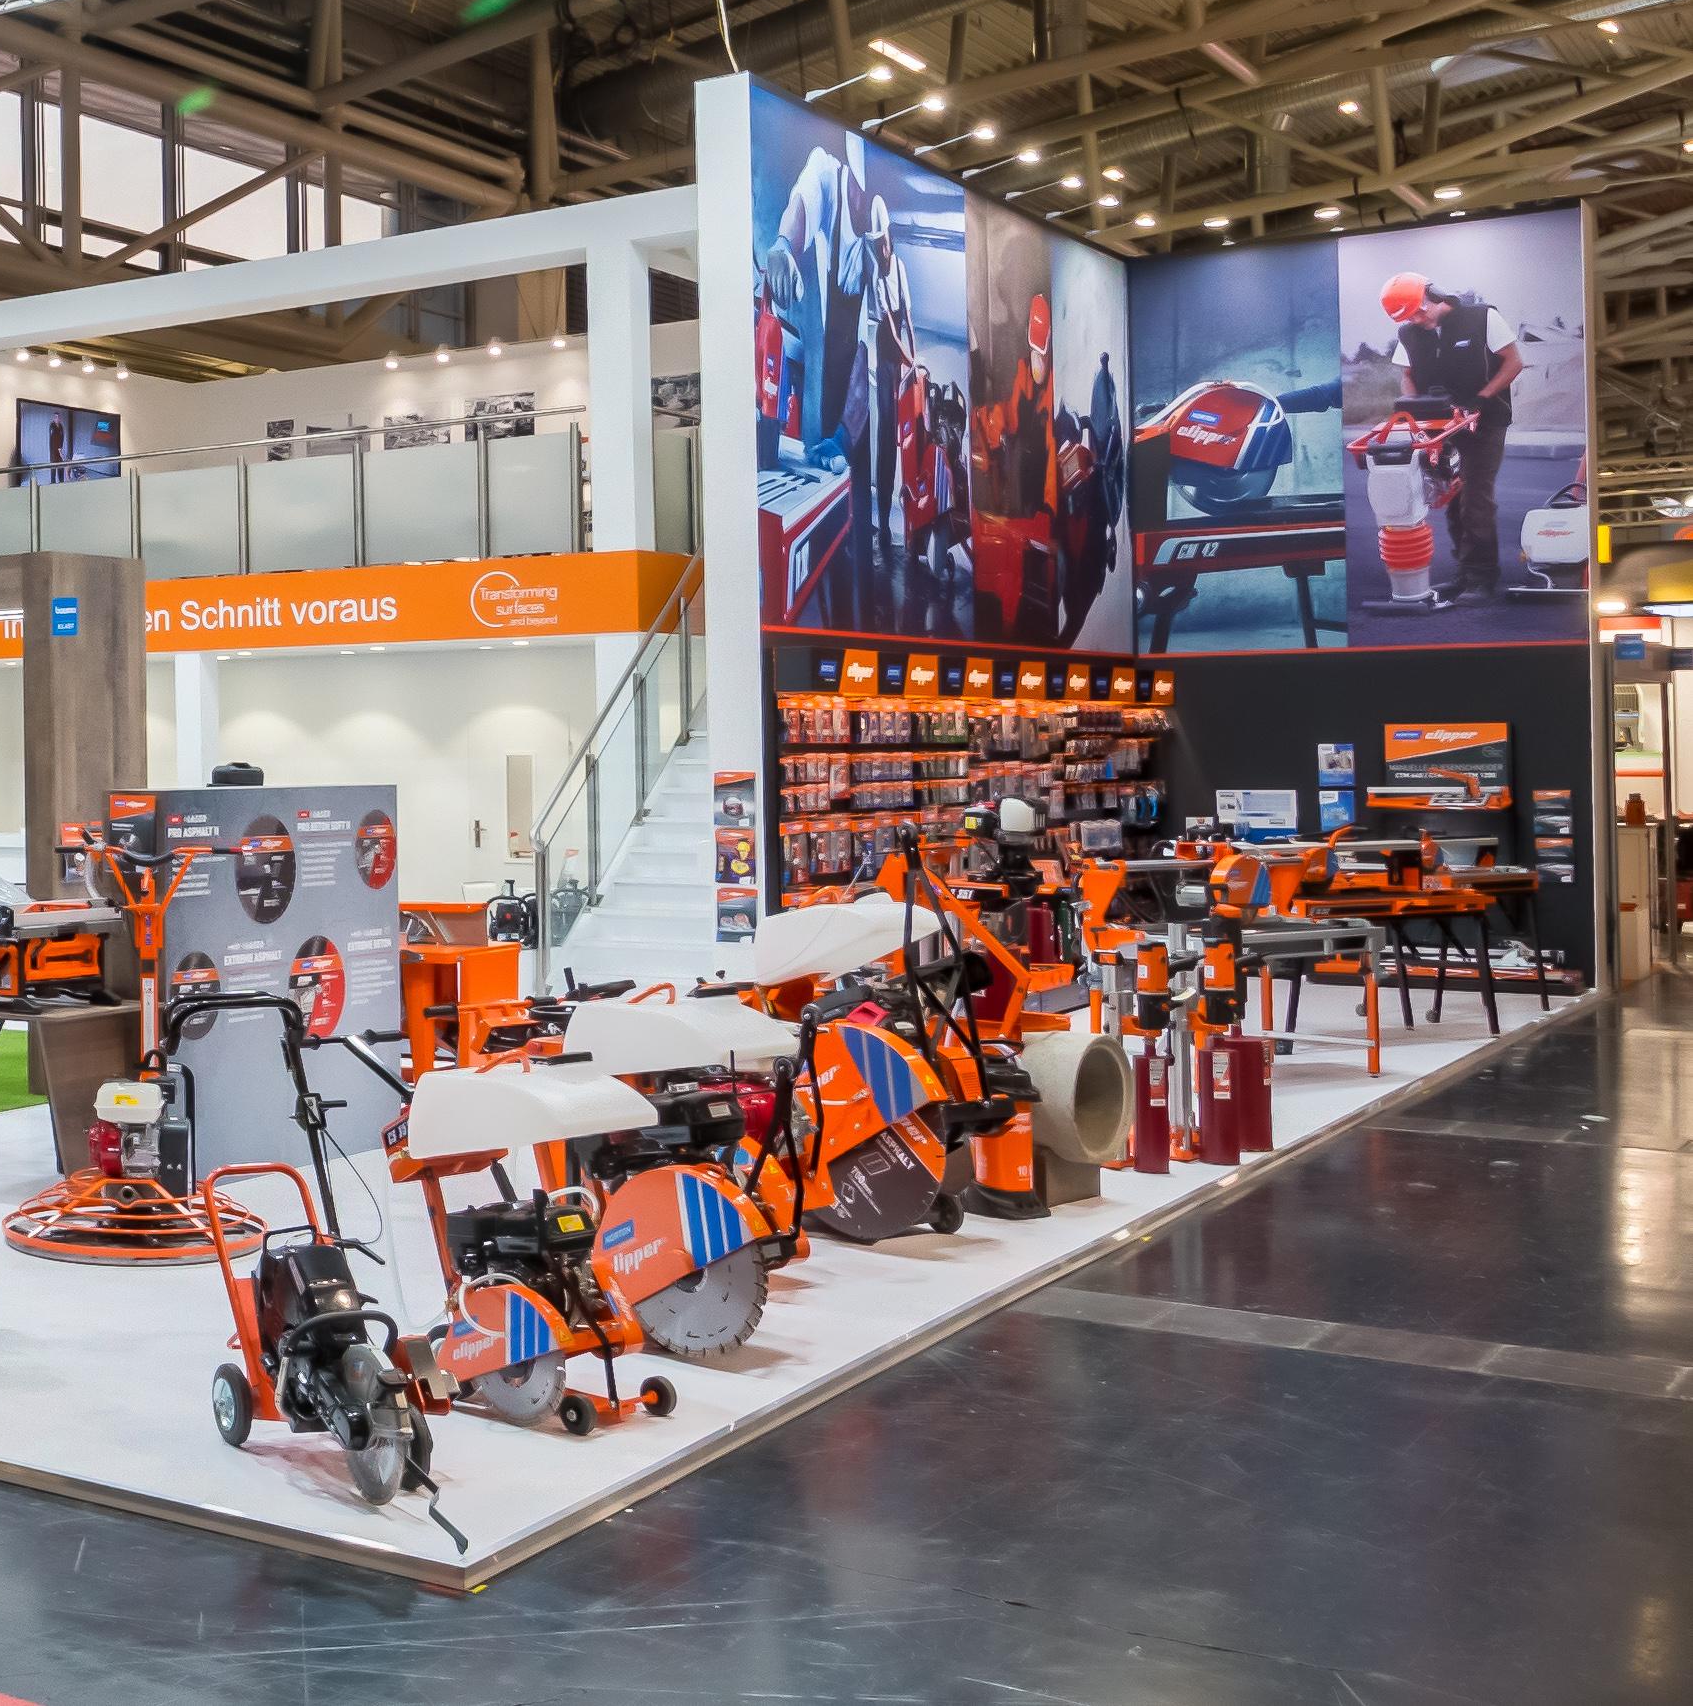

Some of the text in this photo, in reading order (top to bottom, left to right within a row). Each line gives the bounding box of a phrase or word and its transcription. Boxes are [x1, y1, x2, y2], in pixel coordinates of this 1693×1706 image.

[480, 586, 558, 601] Transforming
[180, 598, 282, 631] Schnitt
[290, 596, 398, 625] voraus
[496, 599, 545, 615] surfaces
[612, 1238, 665, 1275] lipper
